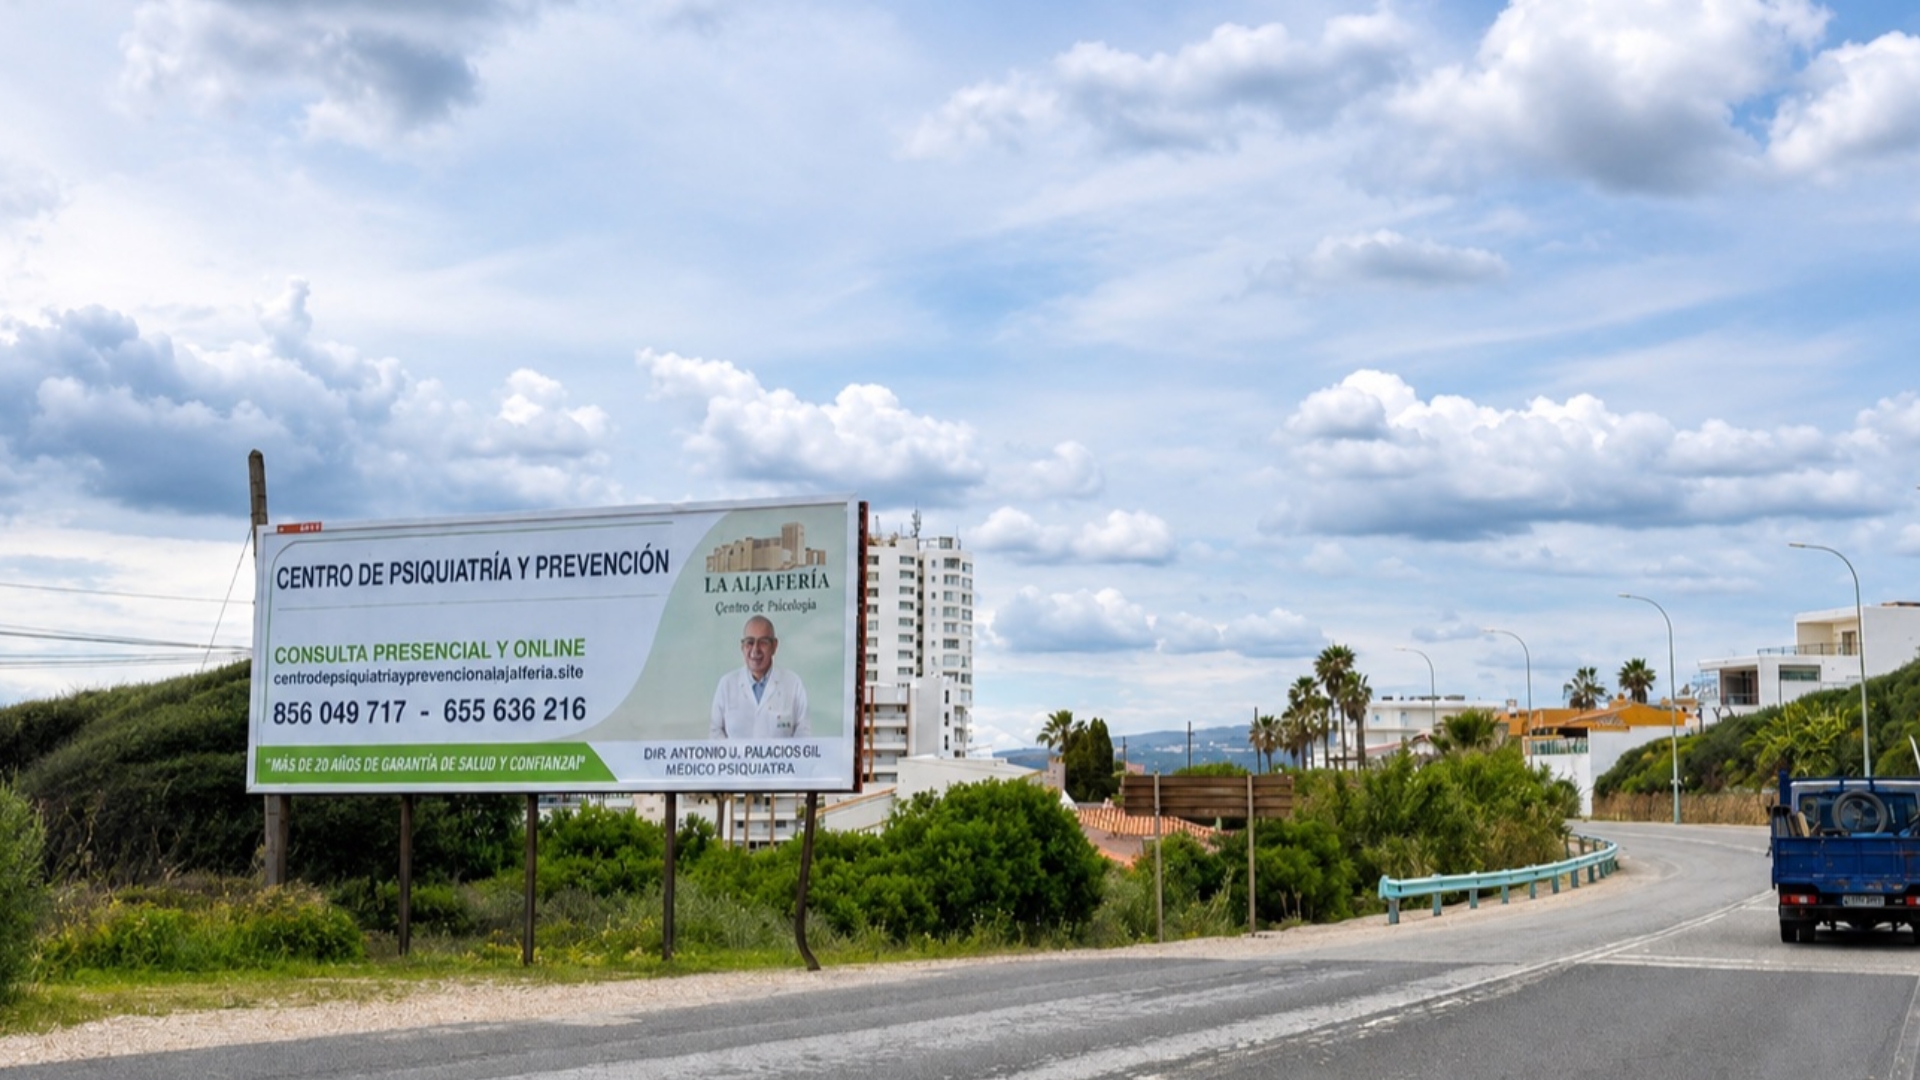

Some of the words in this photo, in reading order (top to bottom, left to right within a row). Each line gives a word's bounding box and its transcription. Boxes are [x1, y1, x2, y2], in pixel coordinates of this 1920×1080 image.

[276, 563, 353, 590] CENTRO
[358, 562, 384, 586] DE
[390, 550, 512, 585] PSIQUIATRÍA
[517, 555, 530, 580] Y
[536, 542, 669, 579] PREVENCIÓN
[705, 576, 728, 593] LA
[732, 568, 830, 595] ALJAFERÍA
[275, 644, 368, 664] CONSULTA
[373, 640, 492, 662] PRESENCIAL
[497, 640, 508, 658] Y
[514, 638, 585, 658] ONLINE
[273, 701, 312, 725] 856
[319, 700, 359, 725] 049
[367, 700, 406, 723] 717
[444, 698, 485, 722] 655
[493, 697, 535, 722] 636
[543, 696, 586, 721] 216
[298, 757, 314, 772] DE
[314, 757, 329, 772] 20
[363, 757, 379, 772] DE
[381, 753, 437, 772] GARANTÍA
[440, 756, 457, 771] DE
[458, 756, 496, 772] SALUD
[499, 755, 508, 771] Y
[669, 746, 727, 760] ANTONIO
[744, 745, 801, 758] PALACIOS
[803, 745, 821, 758] GIL
[717, 761, 795, 775] PSIQUIATRA
